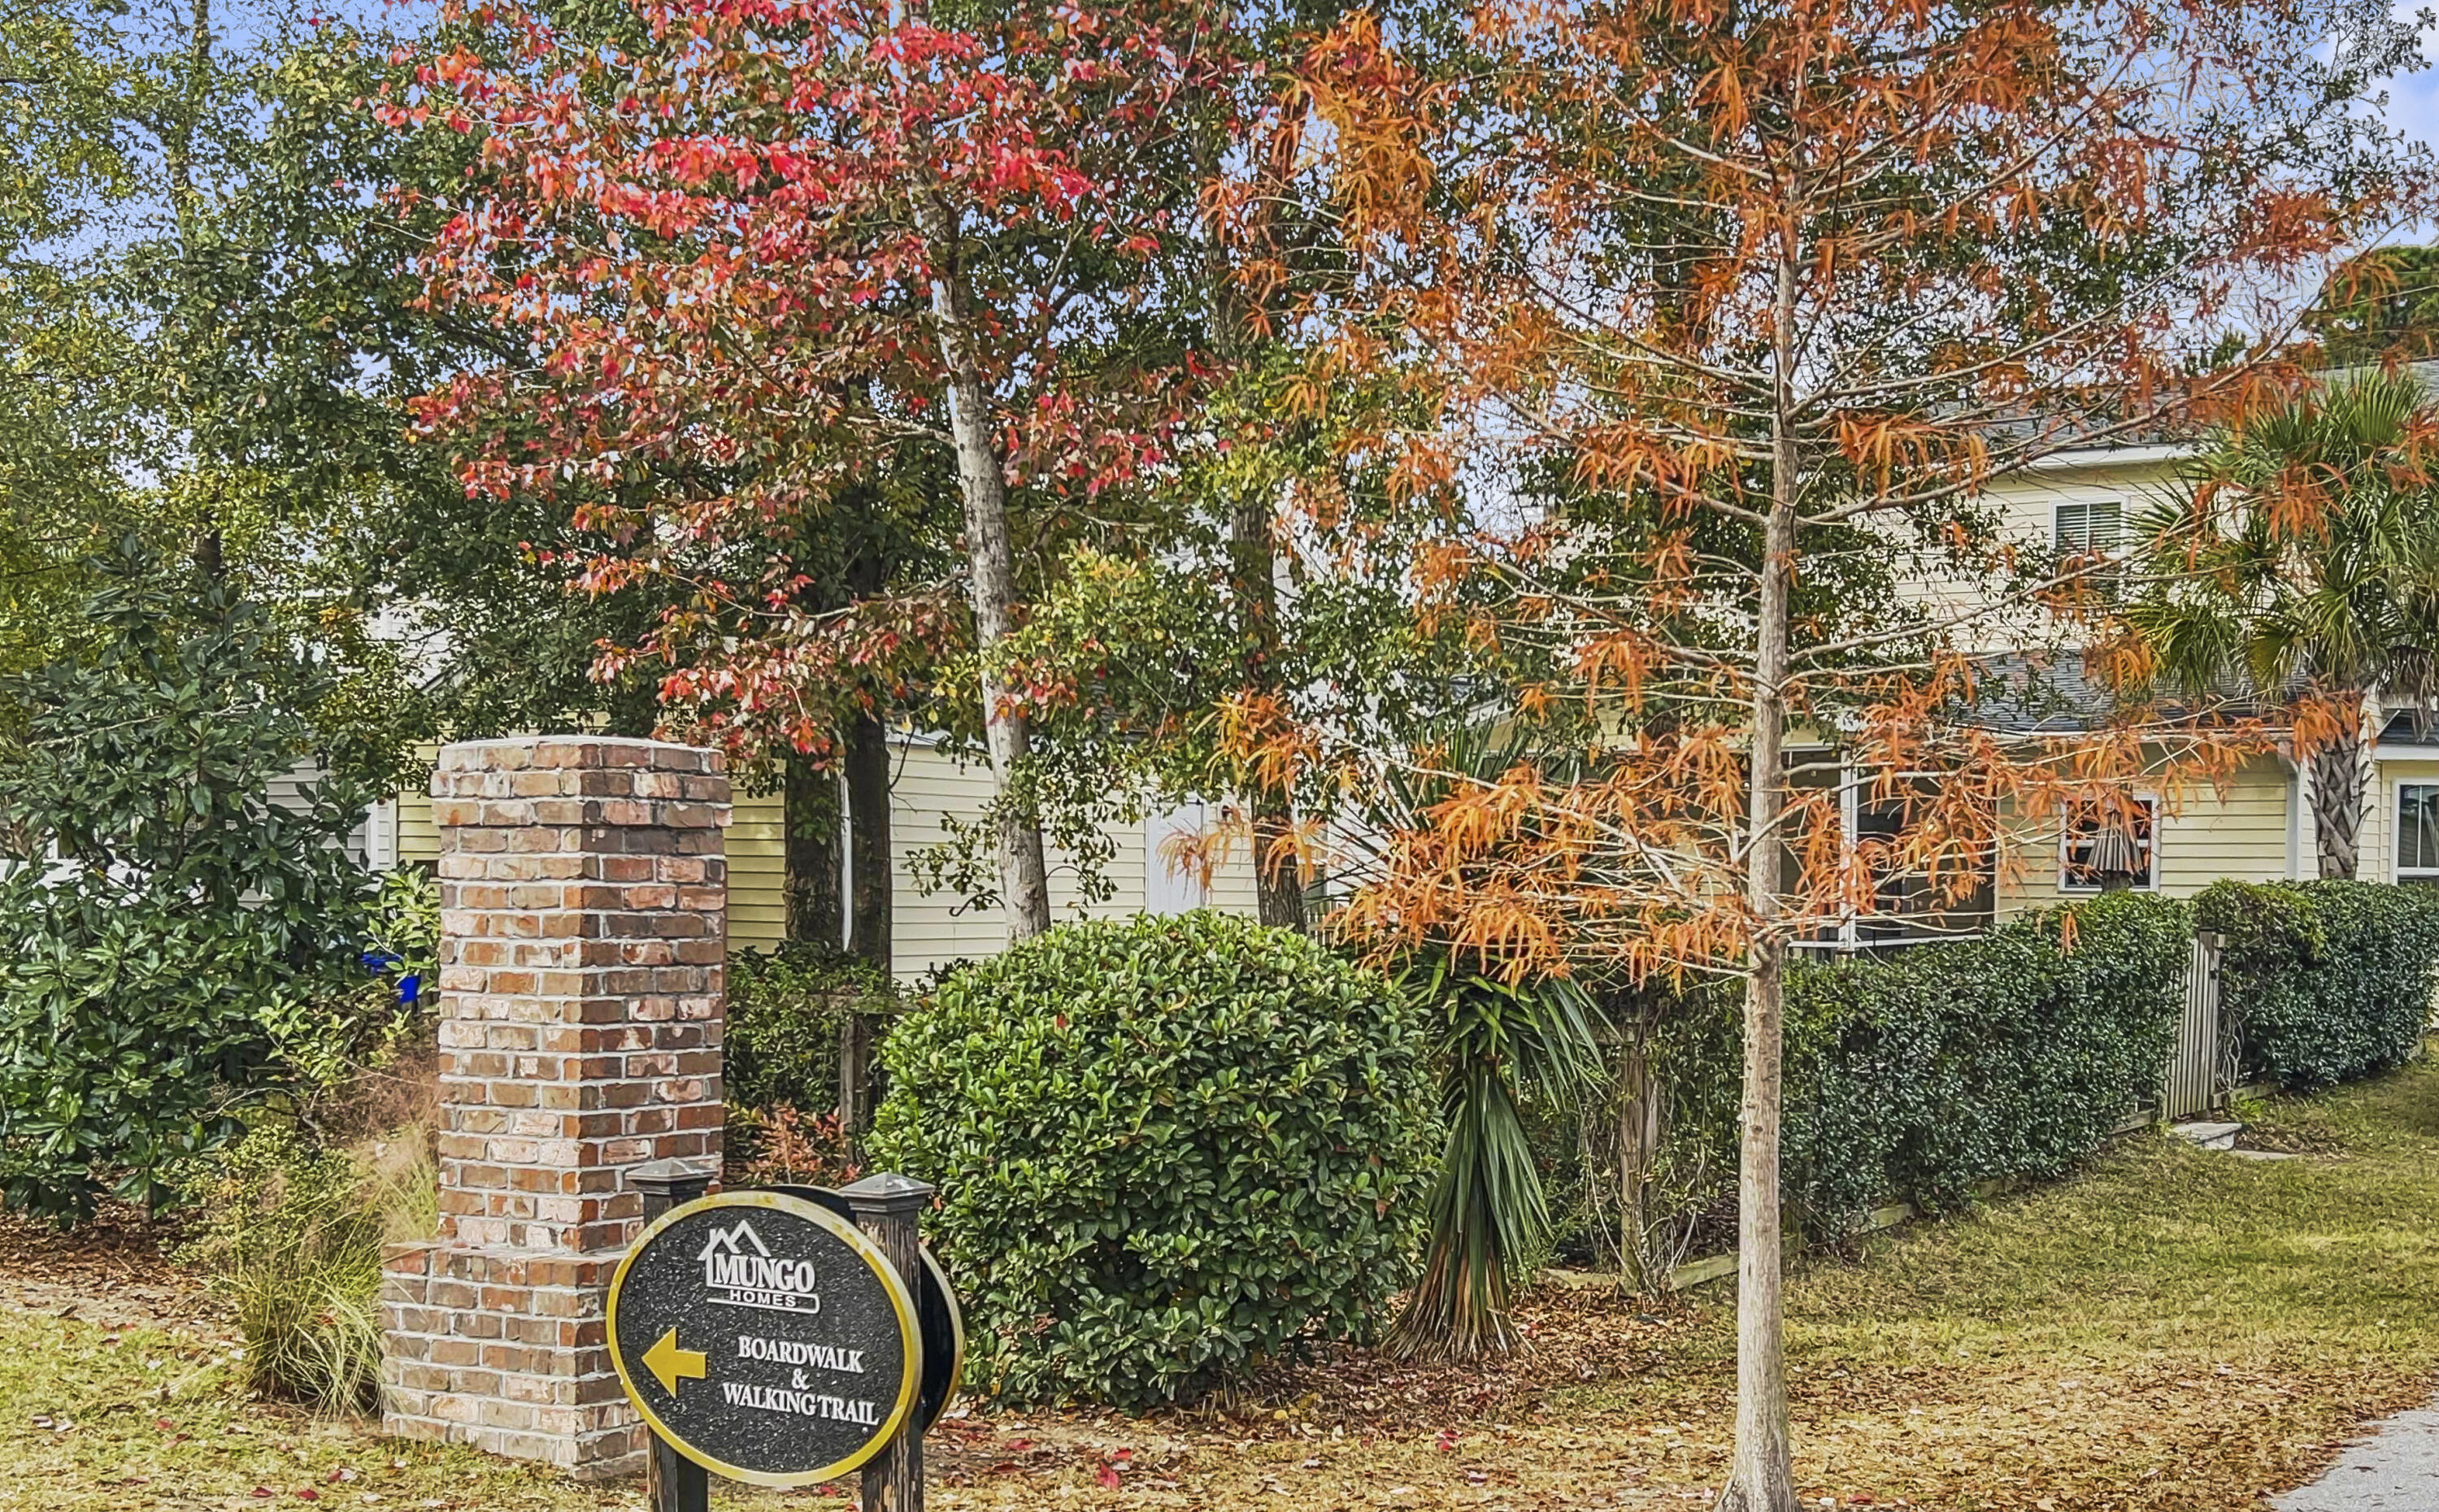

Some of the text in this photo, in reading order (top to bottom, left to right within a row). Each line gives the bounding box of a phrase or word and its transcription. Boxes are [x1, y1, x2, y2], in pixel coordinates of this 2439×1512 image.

[715, 1253, 815, 1293] MUNGO
[730, 1289, 797, 1307] HOMES
[738, 1336, 863, 1374] BOARDWALK
[791, 1368, 811, 1390] &
[723, 1383, 880, 1426] WALKING TRAIL
